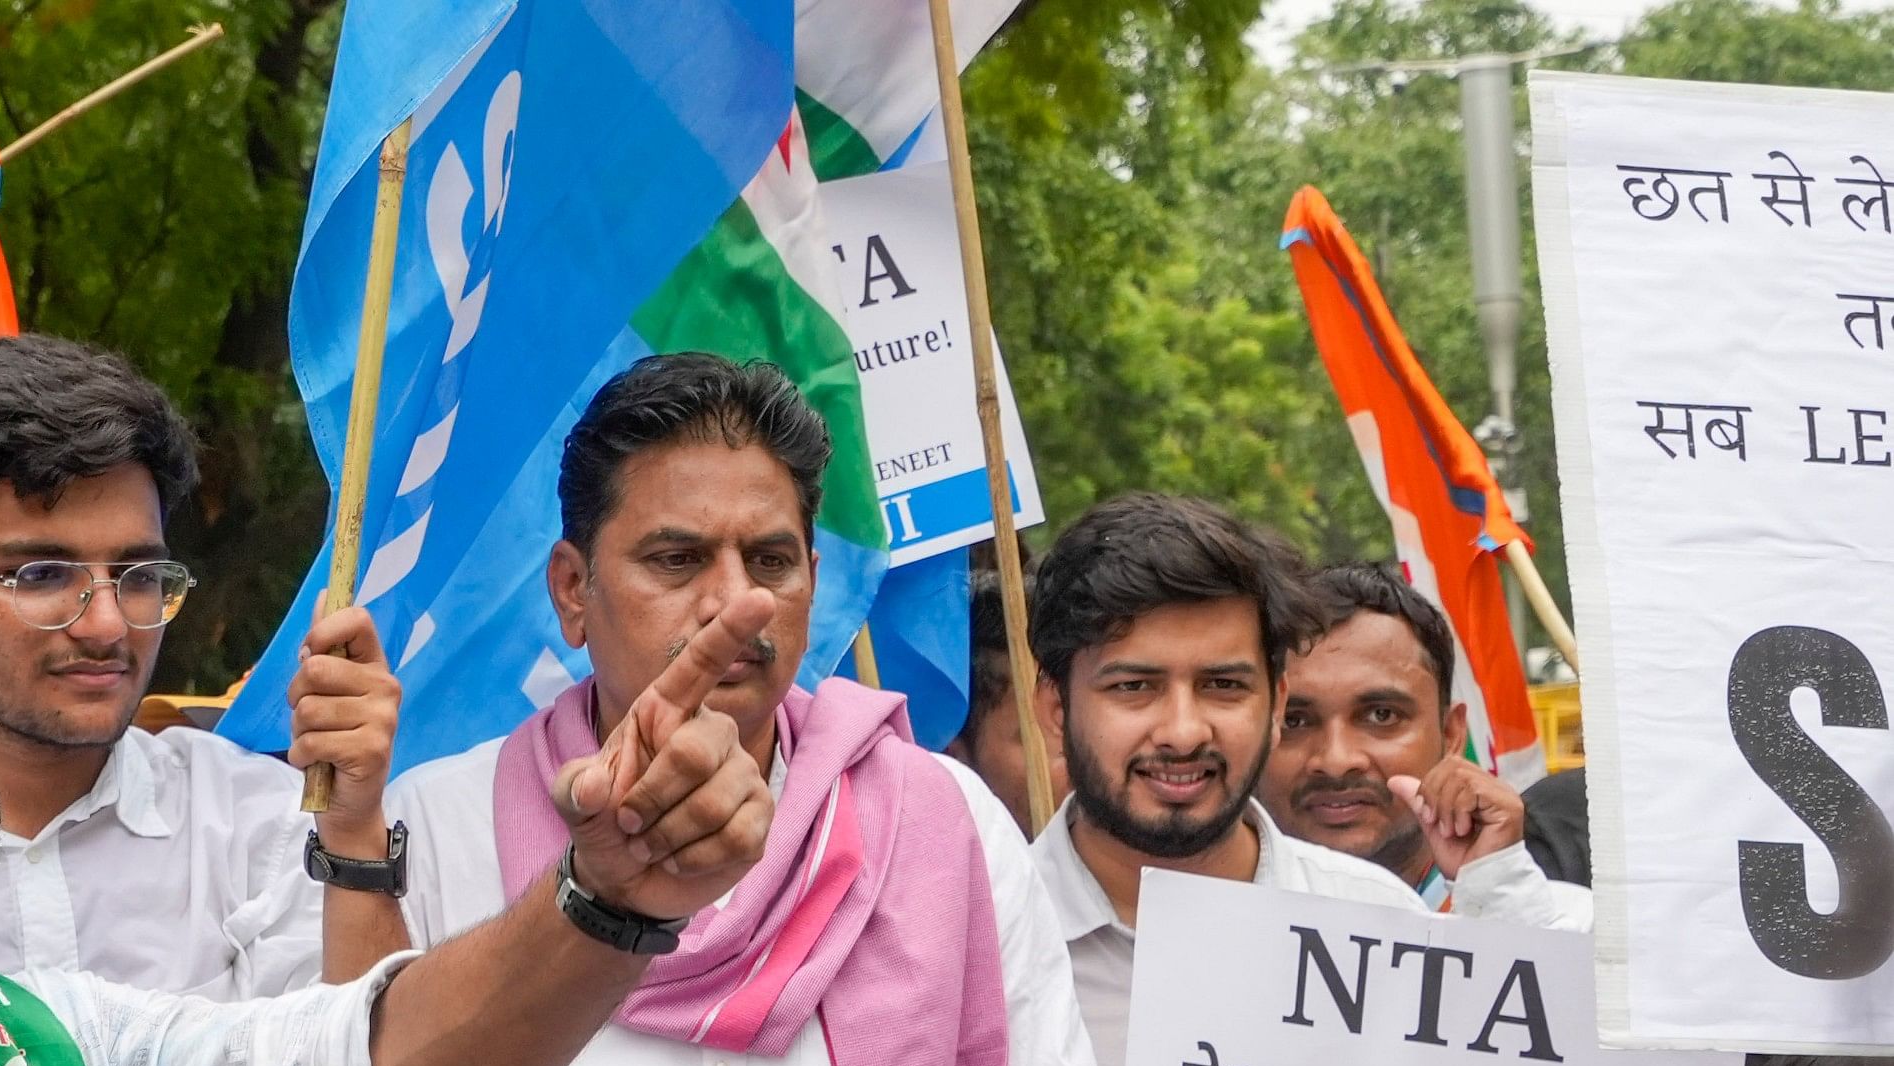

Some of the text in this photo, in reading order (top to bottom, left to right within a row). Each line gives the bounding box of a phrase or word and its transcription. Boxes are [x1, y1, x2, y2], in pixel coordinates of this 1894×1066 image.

[1616, 164, 1733, 223] छत
[1752, 151, 1815, 228] से
[854, 320, 952, 372] uture!
[1636, 401, 1752, 462] सब
[873, 443, 951, 483] ENEET
[1282, 925, 1564, 1062] NTA
